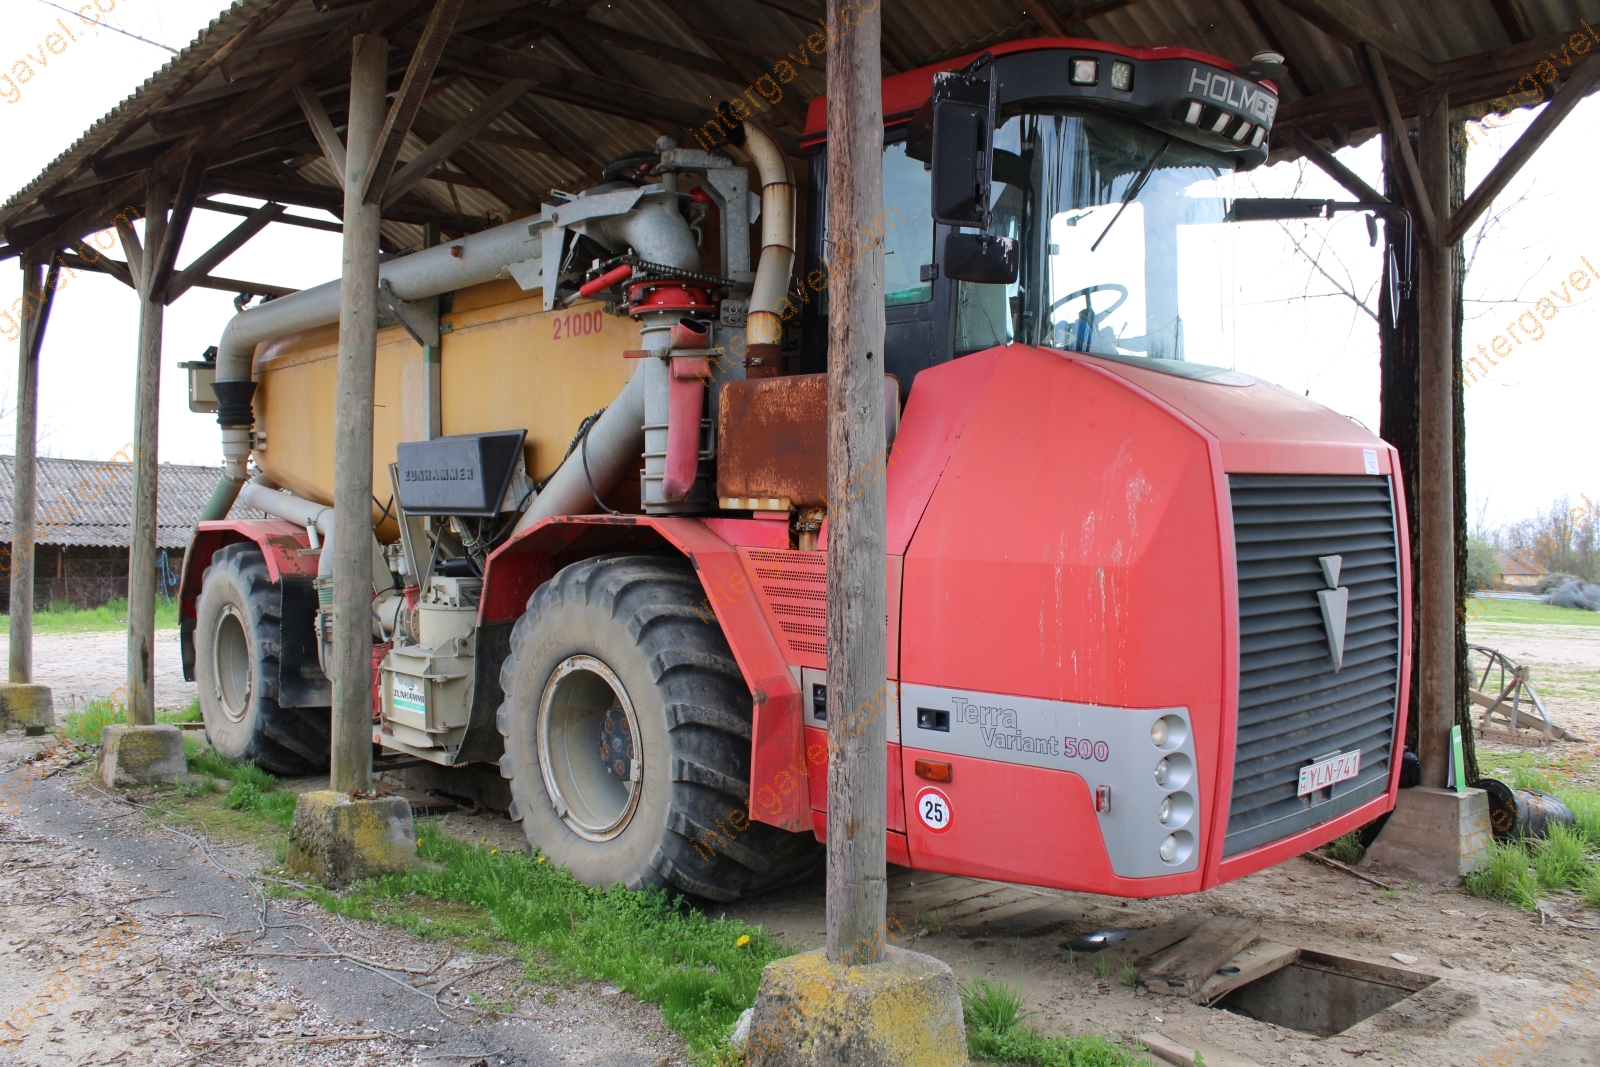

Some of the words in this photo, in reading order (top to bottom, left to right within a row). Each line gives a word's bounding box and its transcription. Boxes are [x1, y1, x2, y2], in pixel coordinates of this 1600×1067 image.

[1188, 67, 1278, 127] HOLMER
[553, 309, 603, 340] 21000
[404, 467, 474, 481] ZUNHAMMER
[952, 697, 1018, 729] Terra
[980, 727, 1059, 756] Variant
[1064, 737, 1109, 762] 500
[1310, 755, 1357, 788] YLN-741
[925, 800, 943, 823] 25
